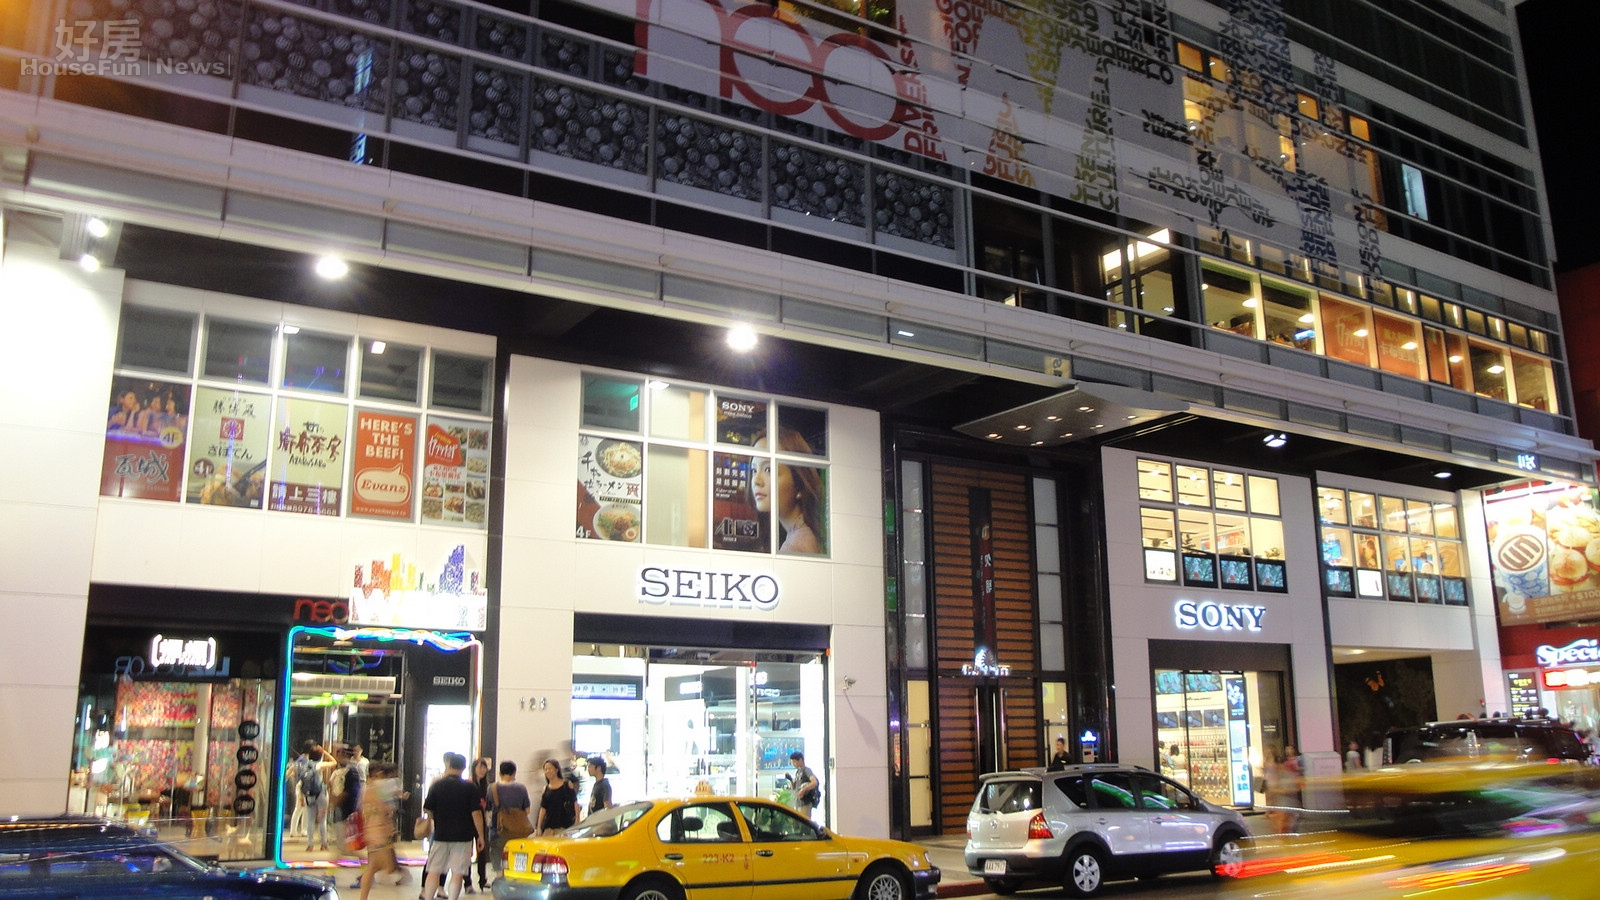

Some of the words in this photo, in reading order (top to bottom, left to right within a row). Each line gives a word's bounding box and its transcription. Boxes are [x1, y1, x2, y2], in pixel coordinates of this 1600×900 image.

[633, 0, 902, 140] neo
[722, 401, 755, 413] SONY
[360, 417, 413, 436] HERE'S
[162, 430, 178, 444] 4F
[372, 431, 400, 447] THE
[365, 444, 404, 461] BEEF!
[115, 450, 170, 484] 瓦城
[194, 460, 214, 478] 4F
[271, 483, 338, 505] 請上三樓
[360, 478, 406, 493] Evans
[577, 525, 591, 539] 4F
[640, 567, 779, 604] SEIKO
[293, 598, 349, 624] neo
[1178, 602, 1267, 629] SONY
[1536, 638, 1600, 667] Speci
[433, 676, 466, 686] SEIKO
